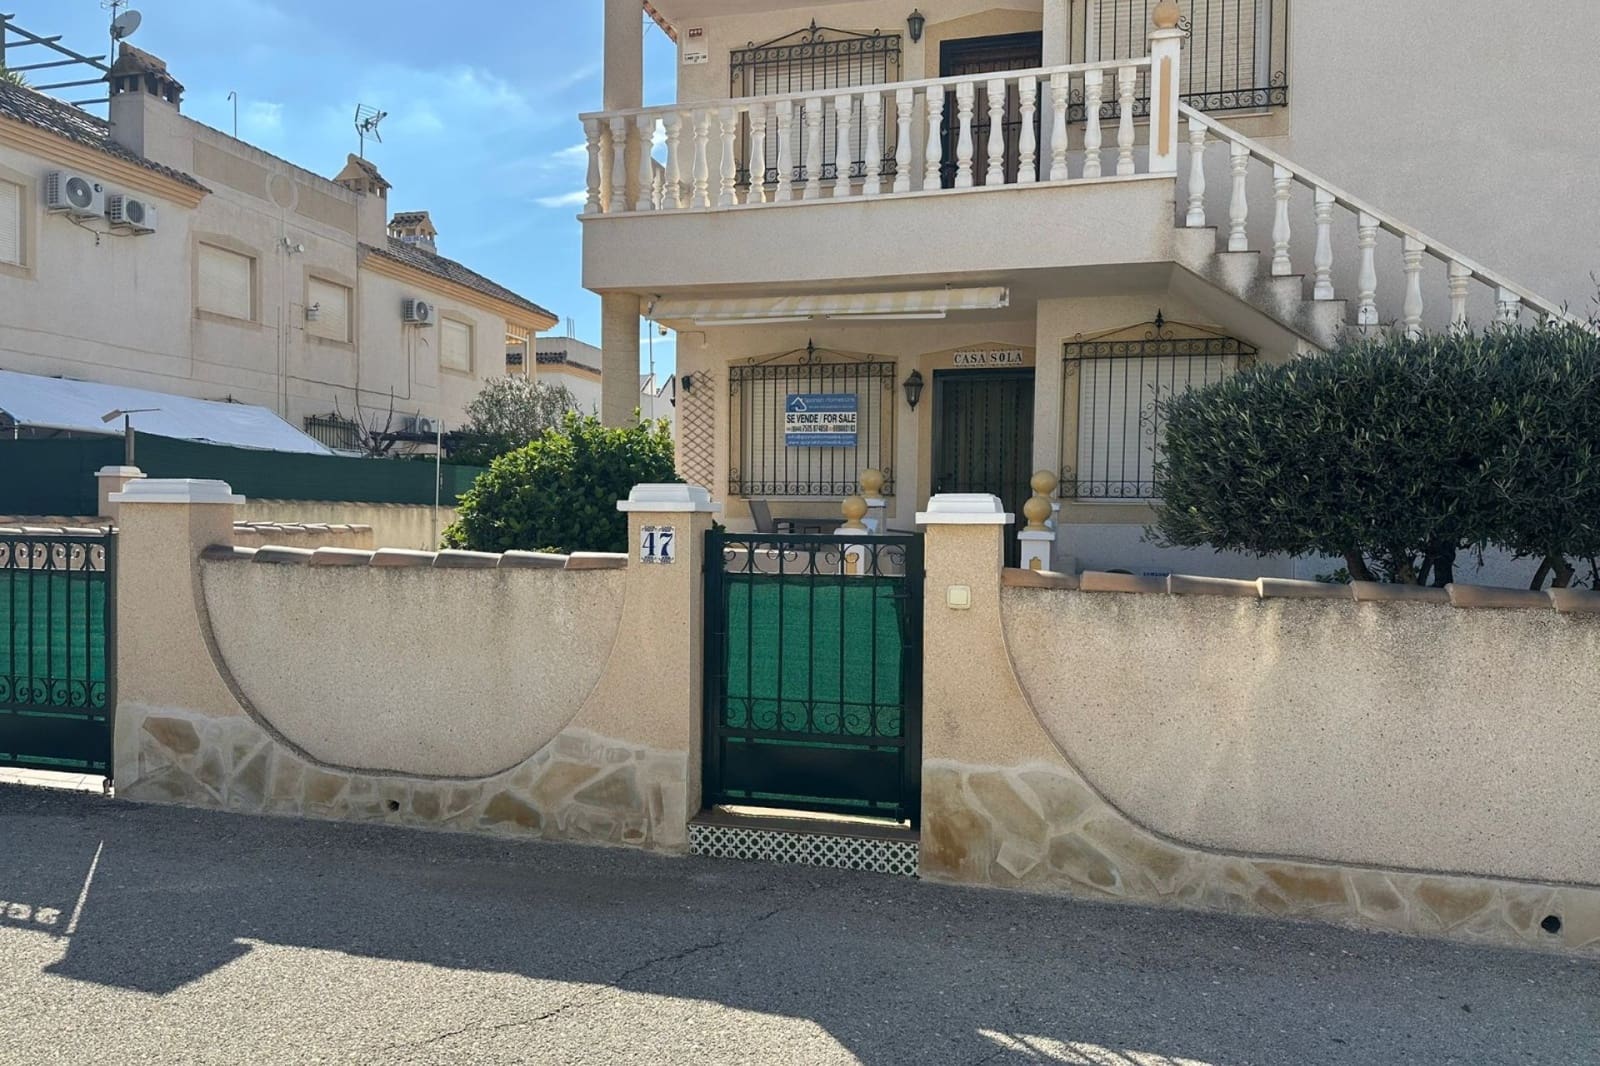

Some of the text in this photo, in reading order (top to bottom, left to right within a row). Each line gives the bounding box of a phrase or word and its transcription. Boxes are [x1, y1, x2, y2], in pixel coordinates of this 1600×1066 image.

[954, 352, 1022, 364] CASA SOLA
[787, 414, 796, 423] SE
[797, 414, 819, 423] VENDE
[823, 414, 837, 423] FOR
[838, 414, 856, 423] SALE
[642, 532, 673, 556] 47
